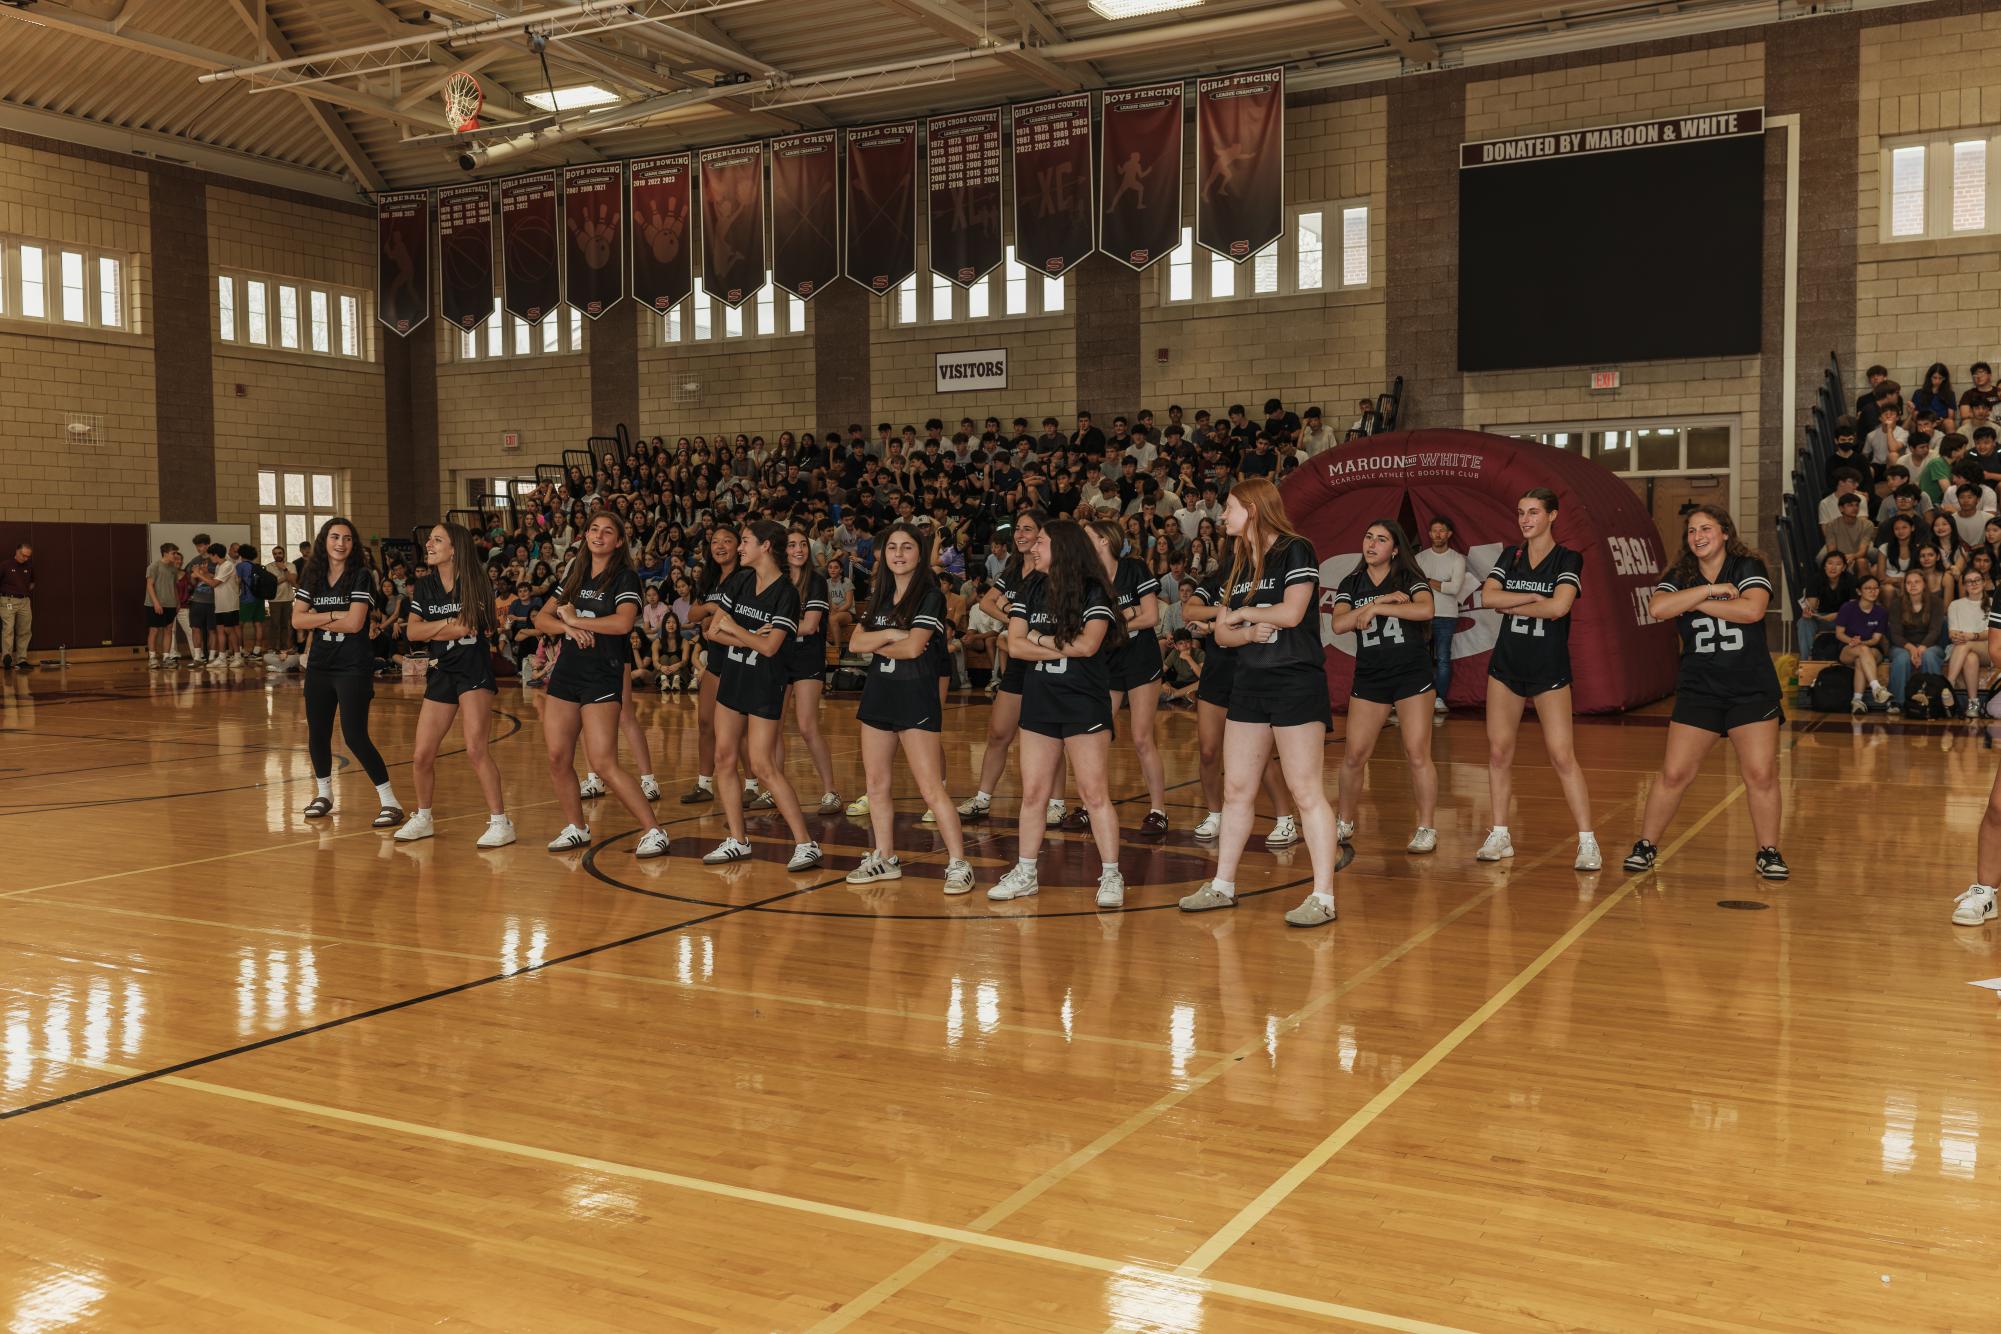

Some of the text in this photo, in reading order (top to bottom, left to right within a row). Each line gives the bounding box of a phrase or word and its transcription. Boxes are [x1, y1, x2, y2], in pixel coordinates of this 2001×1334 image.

[1200, 73, 1280, 93] GIRLS FENCING
[1104, 87, 1181, 104] BOYS FENCING
[1014, 98, 1088, 118] GIRLS CROSS COUNTRY
[931, 113, 998, 131] BOYS CROSS COUNTRY
[849, 126, 914, 141] GIRLS CREW
[1482, 114, 1739, 162] DONATED BY MAROON & WHITE
[773, 135, 834, 151] BOYS CREW
[702, 145, 760, 162] CHEERLEADING
[566, 165, 620, 179] BOYS BOWLING
[633, 157, 689, 171] GIRLS BOWLING
[455, 185, 488, 194] BASKETBALL
[502, 174, 554, 189] GIRLS BASKETBALL
[939, 361, 1004, 379] VISITORS
[1596, 371, 1616, 388] EXIT
[505, 435, 516, 446] EXIT
[1328, 452, 1484, 477] MAROON AND WHITE
[1330, 469, 1480, 486] SCARSDALE ATHLEIC BOOSTER CLUB
[1506, 579, 1553, 593] SCARSDALE
[313, 596, 349, 606] SCARSDALE
[429, 603, 462, 615] SCARSDAL
[734, 603, 772, 622] CARSDALE
[1360, 616, 1405, 648] 24
[1510, 614, 1545, 637] 21
[1692, 617, 1744, 653] 25
